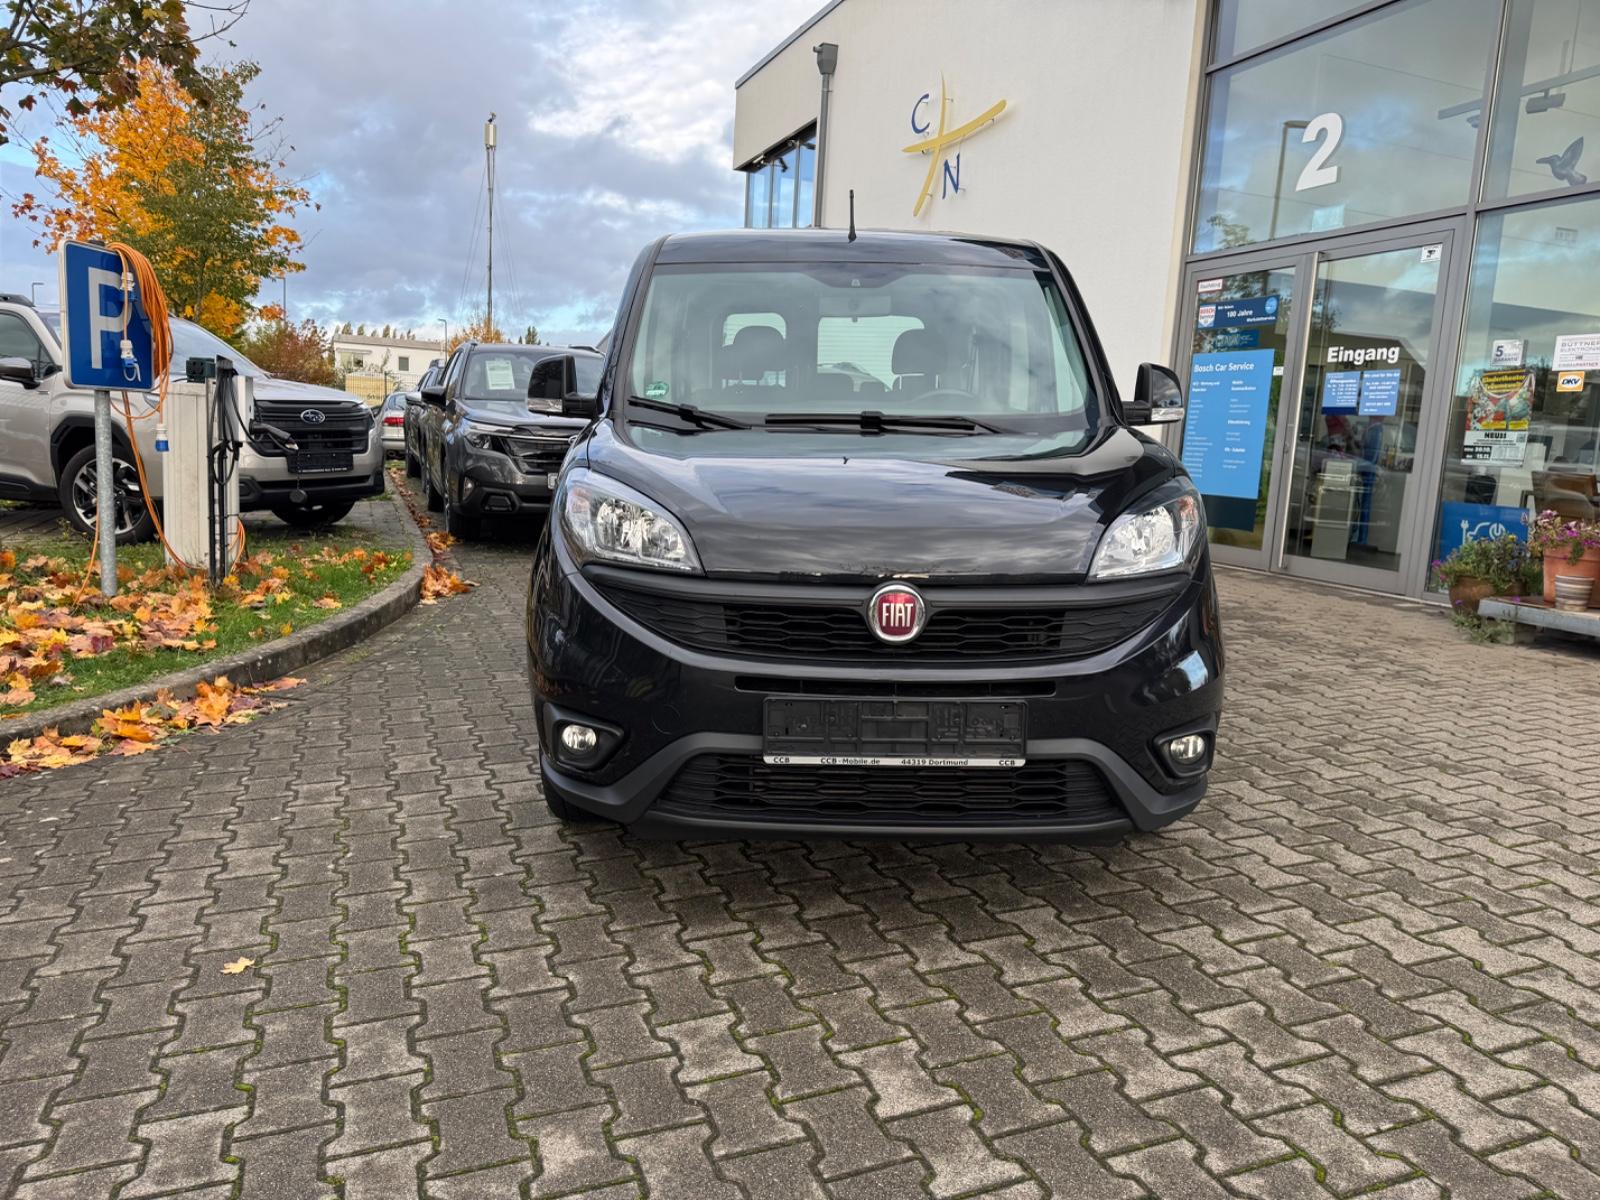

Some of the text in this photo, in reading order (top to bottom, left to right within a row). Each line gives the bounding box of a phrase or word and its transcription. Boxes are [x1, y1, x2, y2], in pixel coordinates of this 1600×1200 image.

[1295, 112, 1343, 192] 2
[87, 266, 133, 369] P
[1327, 346, 1400, 365] Eingang
[1495, 345, 1503, 357] 5
[1194, 362, 1254, 372] Bosch Car Service
[882, 602, 914, 627] FIAT
[998, 759, 1015, 767] CCB
